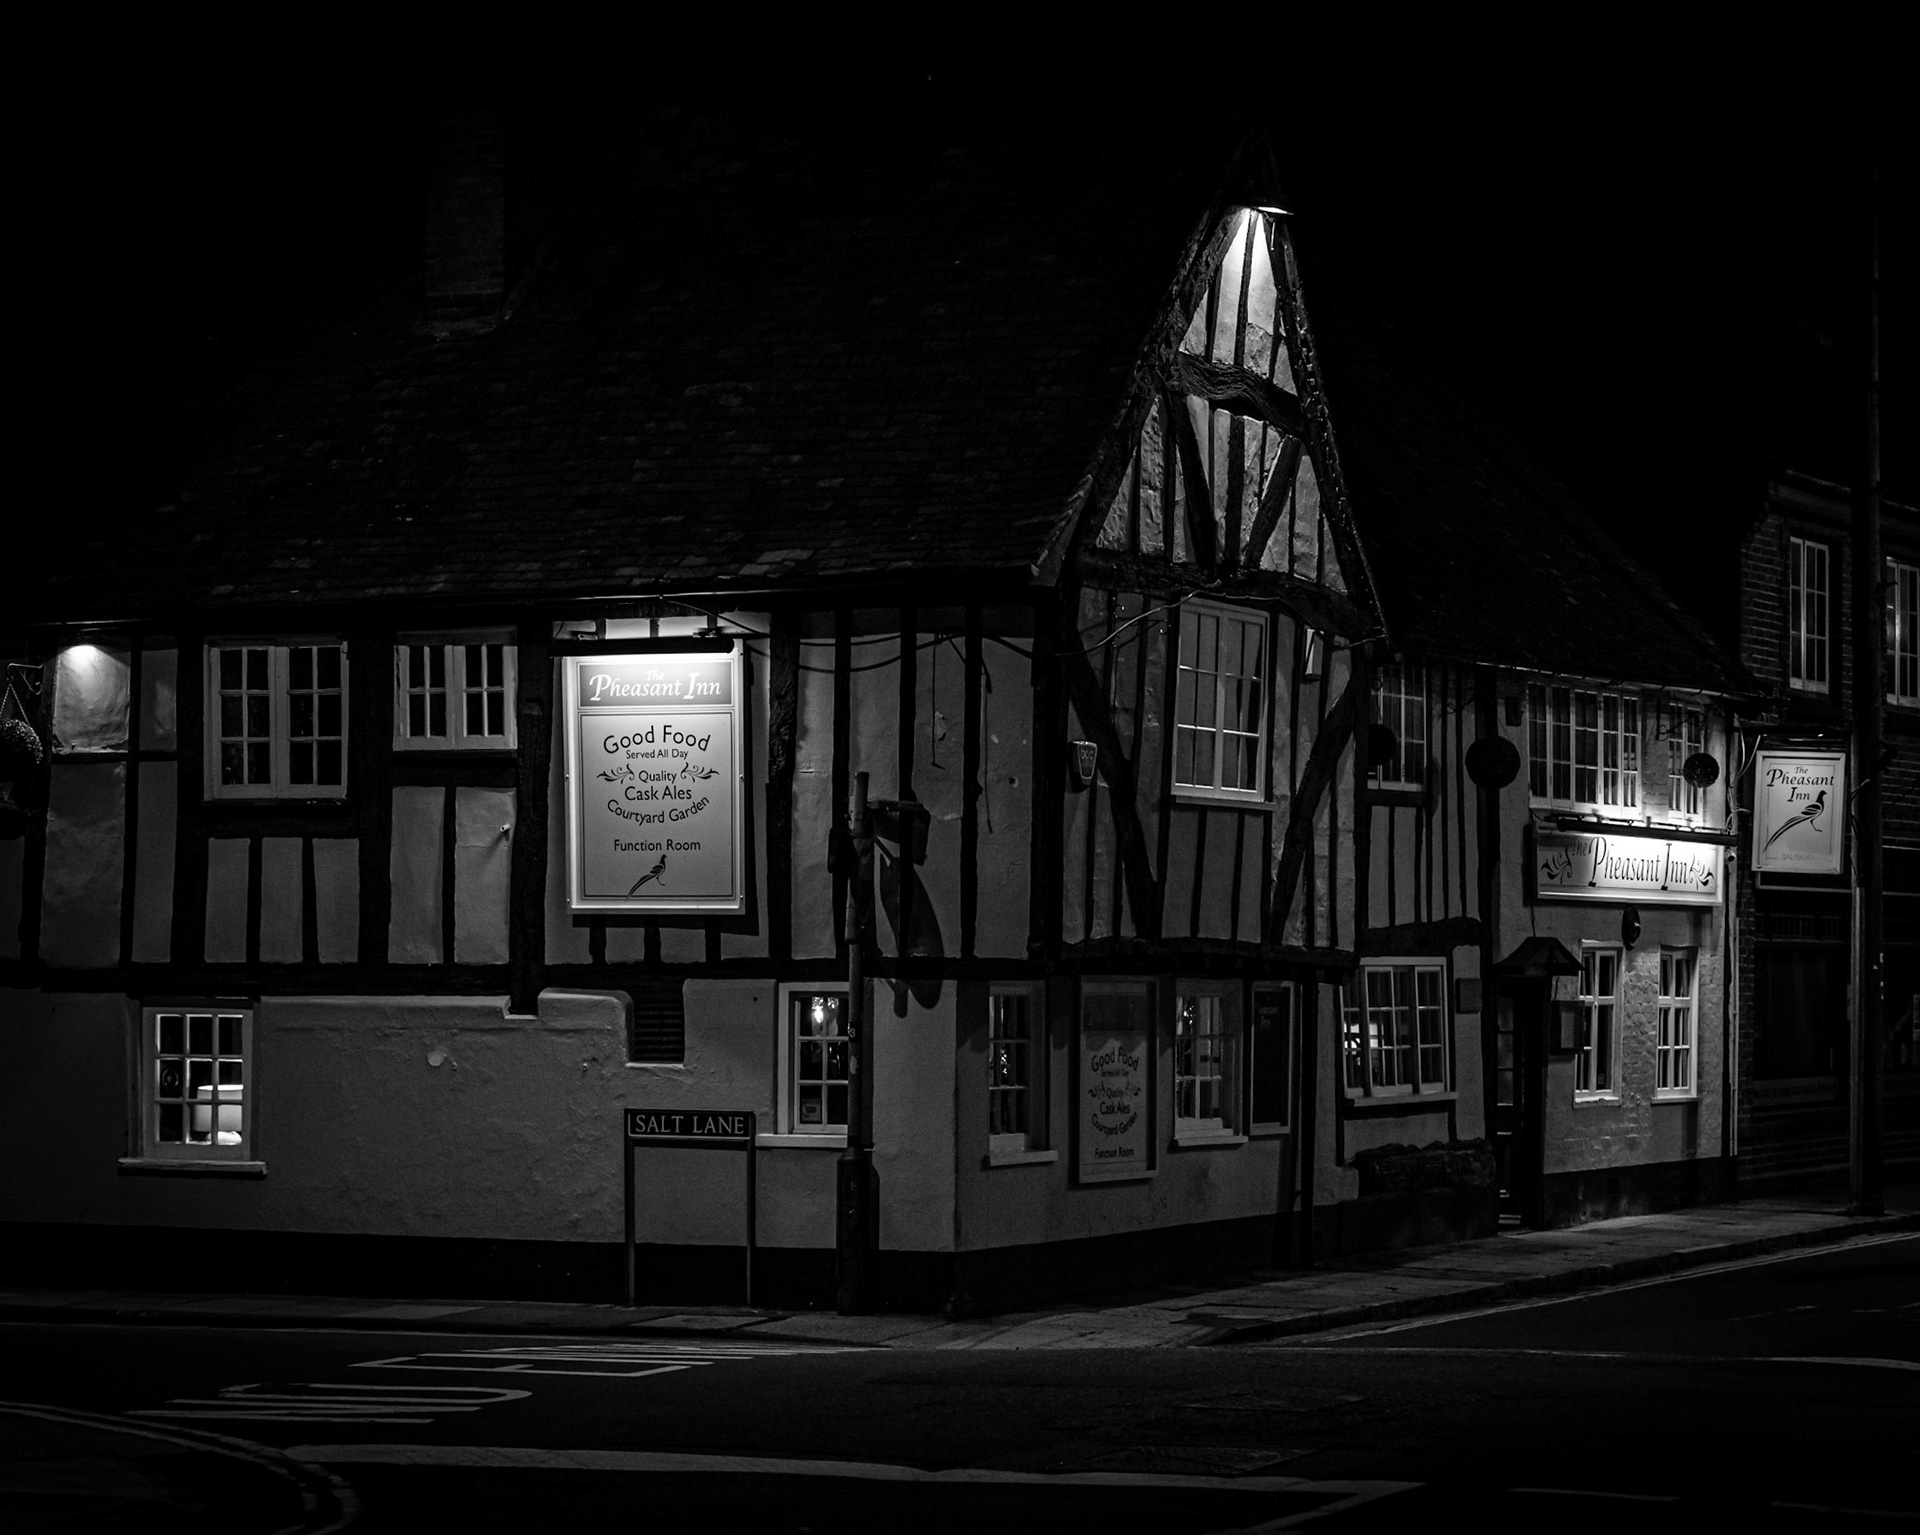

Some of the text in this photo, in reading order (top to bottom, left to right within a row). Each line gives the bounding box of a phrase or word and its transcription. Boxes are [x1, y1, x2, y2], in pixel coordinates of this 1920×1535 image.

[645, 669, 665, 681] The
[589, 672, 722, 701] Pheasant Inn
[603, 725, 711, 754] Good Food
[626, 749, 689, 760] Served All Day
[638, 770, 677, 783] Quality
[1766, 768, 1835, 787] Pheasant
[1794, 766, 1809, 774] The
[624, 785, 692, 801] Cask Ales
[1787, 786, 1810, 802] Inn
[607, 796, 710, 826] Courtyard Garden
[614, 838, 701, 852] Function Room
[1588, 836, 1687, 891] Pheasant Inn
[1091, 1047, 1139, 1072] Good Food
[1100, 1101, 1130, 1115] Cask Ales
[635, 1114, 744, 1135] SALT LANE
[1091, 1112, 1137, 1137] Courtyard Garden
[1095, 1146, 1134, 1159] Function Room
